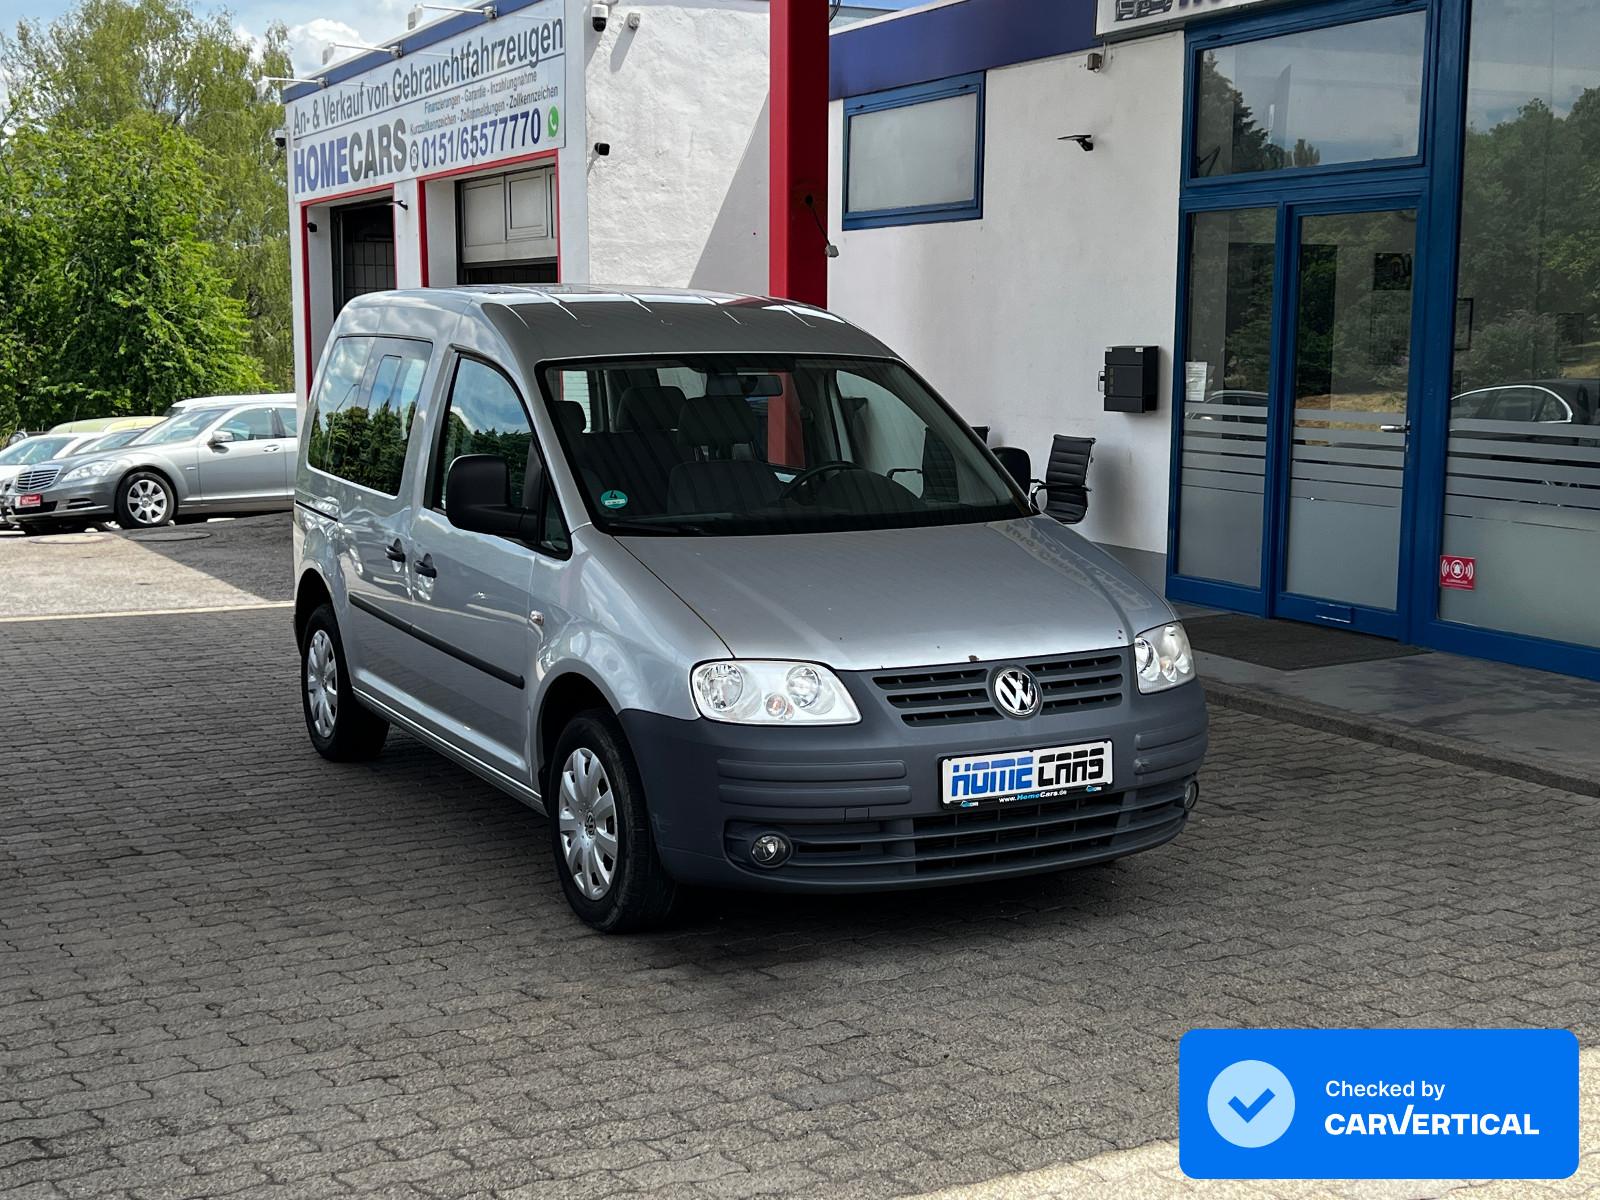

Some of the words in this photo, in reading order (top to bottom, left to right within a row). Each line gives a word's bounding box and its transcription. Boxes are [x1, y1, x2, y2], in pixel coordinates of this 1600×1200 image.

[293, 106, 310, 136] An-
[312, 99, 320, 129] &
[322, 81, 364, 126] Verkauf
[366, 81, 389, 111] von
[392, 17, 563, 102] Gebrauchtfahrzeugen
[464, 86, 486, 100] Garantie
[490, 70, 537, 95] Inzahlungnahme
[509, 85, 559, 109] Zollkennzeichen
[293, 118, 407, 194] HOMECARS
[422, 107, 541, 169] 0151/65577770
[951, 756, 1034, 797] HOME
[998, 789, 1068, 803] www.HomeCars.de
